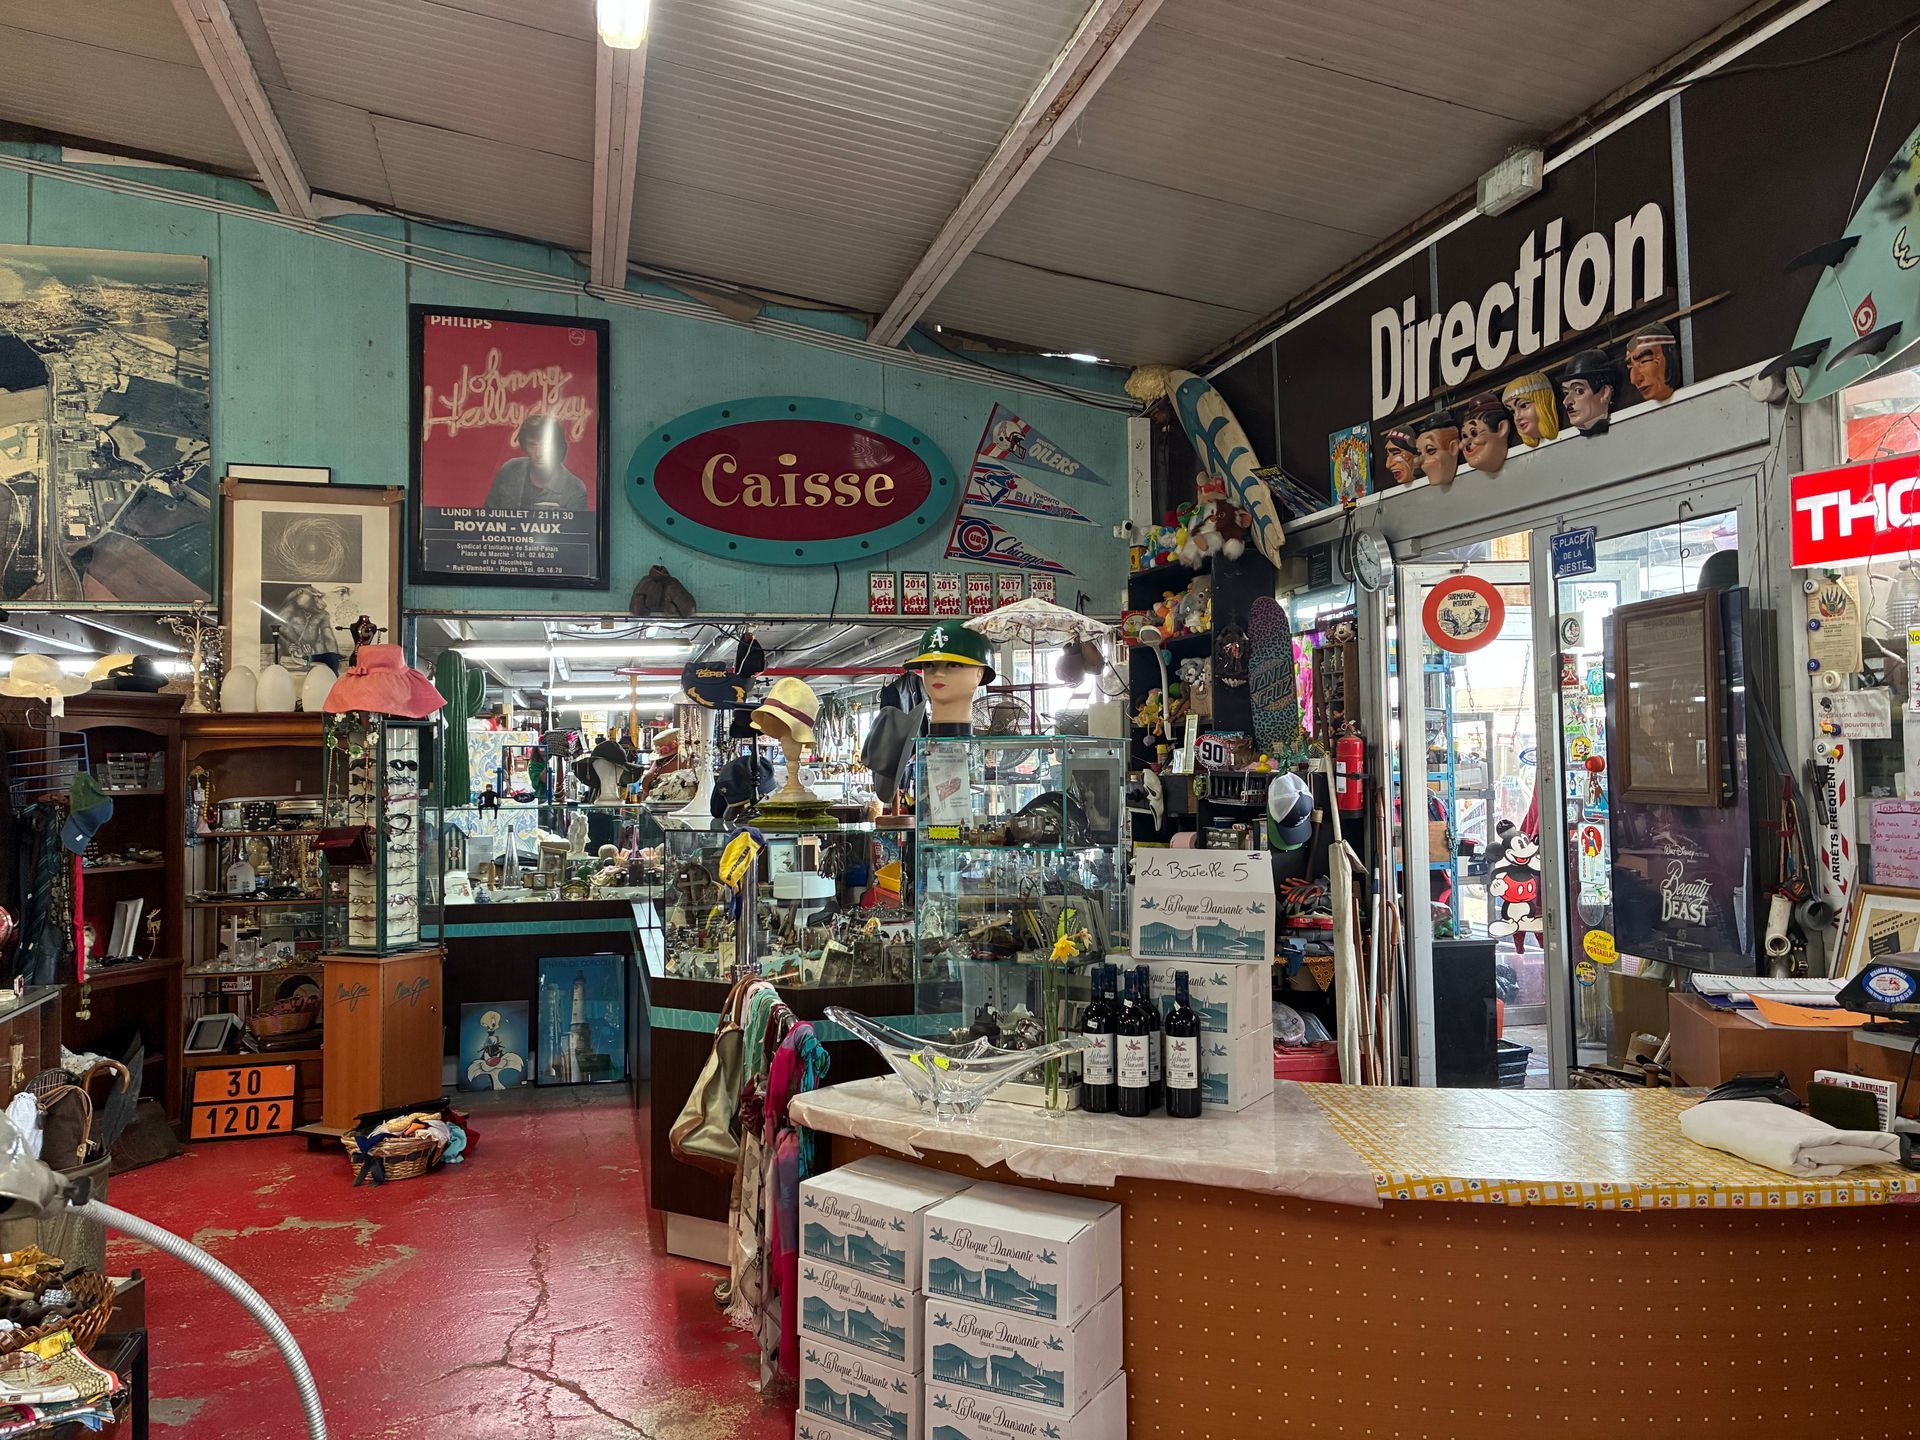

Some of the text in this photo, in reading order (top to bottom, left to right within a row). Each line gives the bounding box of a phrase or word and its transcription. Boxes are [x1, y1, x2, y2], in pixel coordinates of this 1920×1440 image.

[1371, 202, 1664, 422] Direction
[431, 315, 493, 330] PHILIPS
[458, 348, 573, 404] Johnny
[424, 382, 594, 449] Hallyday
[1029, 443, 1080, 476] OILERS
[701, 452, 896, 508] Caisse
[1015, 491, 1044, 509] BLUE
[1033, 492, 1060, 505] TORONTO
[441, 508, 574, 520] LUNDI 18 JUILLET 21 H 30
[454, 521, 507, 533] ROYAN
[520, 522, 561, 534] VAUX
[456, 543, 482, 551] Syndicat
[482, 535, 534, 544] LOCATIONS
[1560, 533, 1585, 548] PLACE
[994, 536, 1045, 568] Chicago
[1563, 550, 1582, 560] DE LA
[1560, 560, 1587, 574] SIESTE
[872, 580, 893, 589] 2013
[905, 580, 926, 589] 2014
[937, 581, 957, 590] 2015
[969, 582, 990, 591] 2016
[1001, 581, 1020, 590] 2017
[1032, 581, 1052, 590] 2018
[869, 596, 897, 608] petit
[902, 596, 930, 608] petit
[933, 597, 961, 608] petit
[966, 597, 993, 609] petit
[1448, 592, 1477, 600] SURMENAGE
[938, 606, 960, 615] futé
[1249, 660, 1290, 694] SANTA
[1259, 674, 1292, 707] CRUZ
[1202, 741, 1223, 763] 90
[1675, 844, 1695, 859] Disney
[1827, 832, 1841, 882] ARRÊTS
[1141, 857, 1249, 881] La Bouteille 5
[1660, 859, 1713, 908] Beauty
[1200, 896, 1244, 915] Dansante
[1661, 889, 1708, 927] BEAST
[227, 1069, 261, 1098] 30
[206, 1103, 281, 1134] 1202
[851, 1203, 886, 1230] Dansante
[989, 1236, 1034, 1262] Dansante
[851, 1279, 886, 1306] Dansante
[995, 1322, 1040, 1349] Dansante
[852, 1361, 889, 1390] Dansante
[993, 1406, 1037, 1435] Dansante
